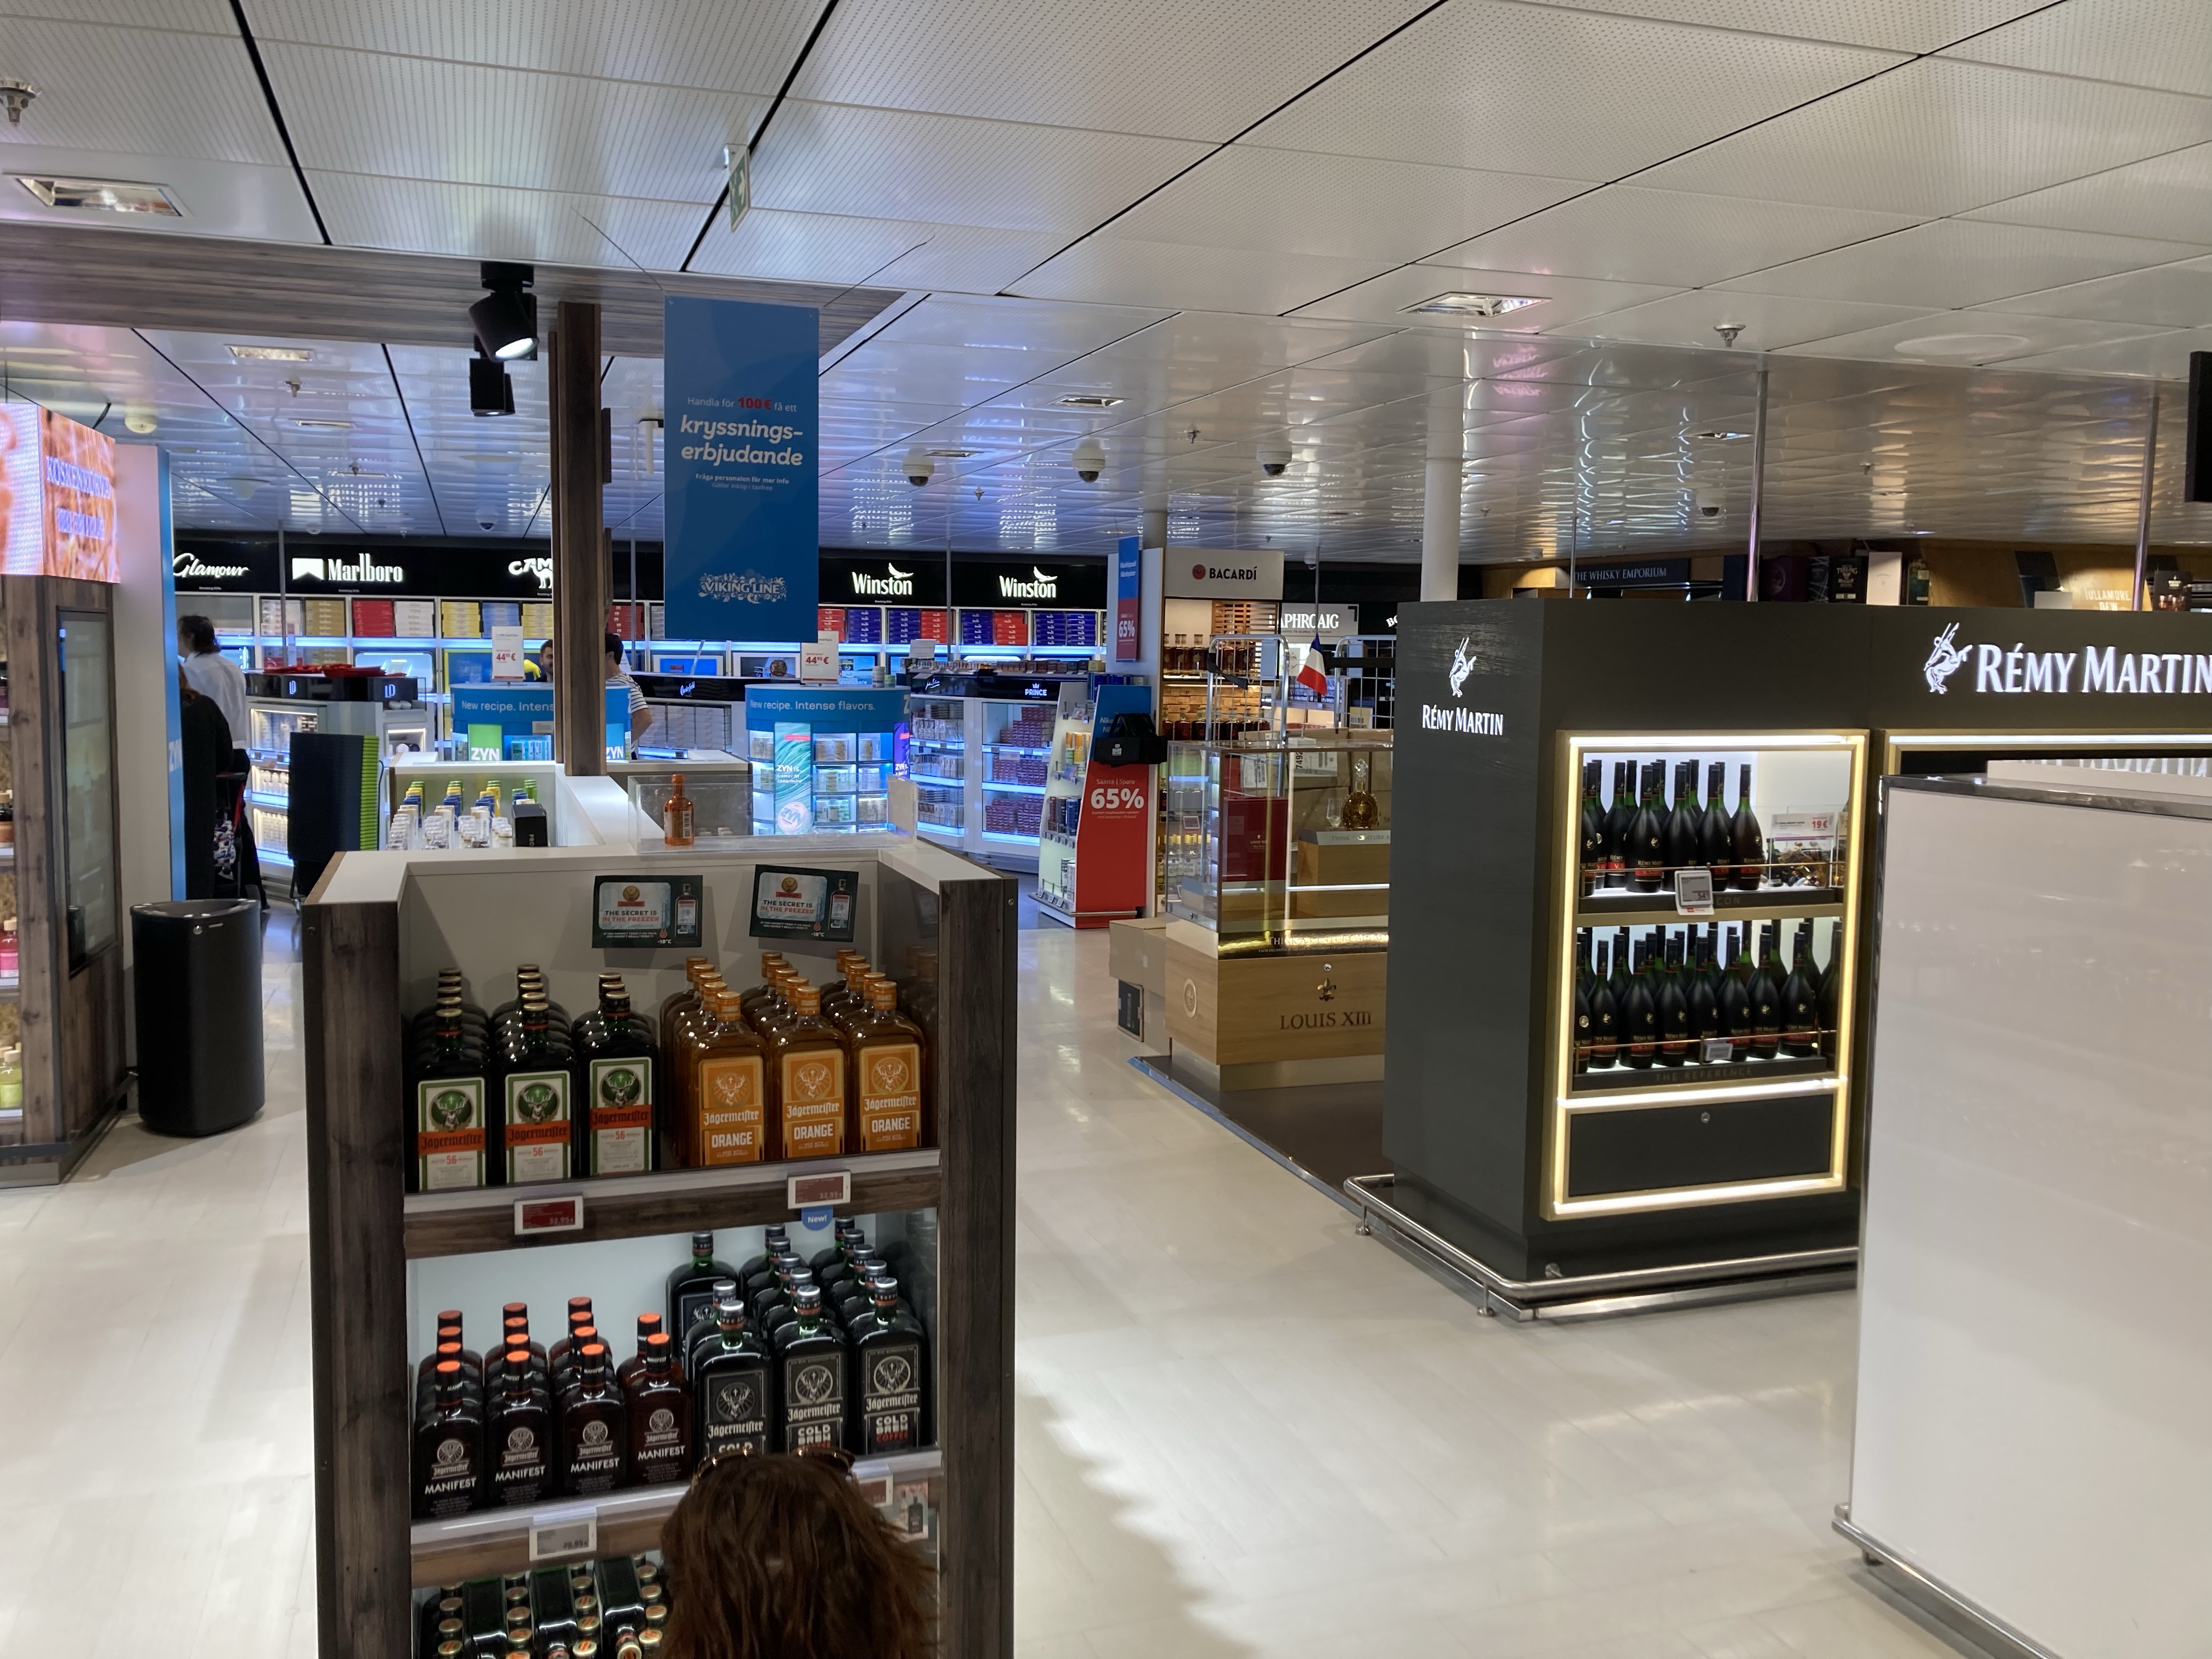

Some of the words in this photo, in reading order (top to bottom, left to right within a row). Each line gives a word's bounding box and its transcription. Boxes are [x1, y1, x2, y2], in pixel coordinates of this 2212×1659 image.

[687, 397, 719, 407] Handla
[722, 398, 735, 408] för
[774, 402, 782, 411] få
[785, 404, 798, 412] ett
[680, 414, 803, 444] kryssnings-
[681, 442, 803, 466] erbjudande
[715, 475, 750, 483] personalen
[173, 552, 249, 578] Glamour
[328, 553, 403, 582] Marlboro
[1209, 566, 1257, 580] BACARDÍ
[1589, 569, 1621, 580] WHISKY
[1622, 567, 1667, 579] EMPORIUM
[704, 582, 750, 593] VIKING
[752, 584, 780, 594] LINE
[851, 572, 913, 595] Winston
[999, 575, 1057, 598] Winston
[2085, 588, 2131, 601] TULLAMORE
[1119, 620, 1135, 637] 65%
[1976, 642, 2078, 693] RÉMY
[462, 700, 478, 710] New
[481, 701, 516, 713] recipe.
[750, 699, 763, 709] New
[764, 701, 793, 712] recipe.
[795, 701, 836, 711] Intense
[838, 701, 876, 711] flavors.
[1422, 704, 1454, 730] RÉMY
[1455, 707, 1503, 736] MARTIN
[471, 748, 500, 761] ZYN
[1091, 788, 1144, 809] 65%
[1716, 896, 1741, 905] CON
[1280, 1012, 1336, 1030] LOUIS
[1340, 1011, 1372, 1026] XIII
[1655, 1073, 1678, 1082] THE
[1684, 1066, 1752, 1080] REFERENCE
[794, 1123, 833, 1140] ORANGE
[871, 1116, 911, 1133] ORANGE
[615, 1131, 625, 1140] 56
[712, 1132, 753, 1148] ORANGE
[446, 1155, 457, 1164] 56
[533, 1147, 543, 1156] 56
[808, 1215, 827, 1223] New!
[876, 1414, 908, 1426] COLD
[798, 1424, 831, 1436] COLD
[637, 1445, 686, 1462] MANIFEST
[495, 1465, 545, 1482] MANIFEST
[571, 1458, 620, 1474] MANIFEST
[425, 1477, 477, 1495] MANIFEST
